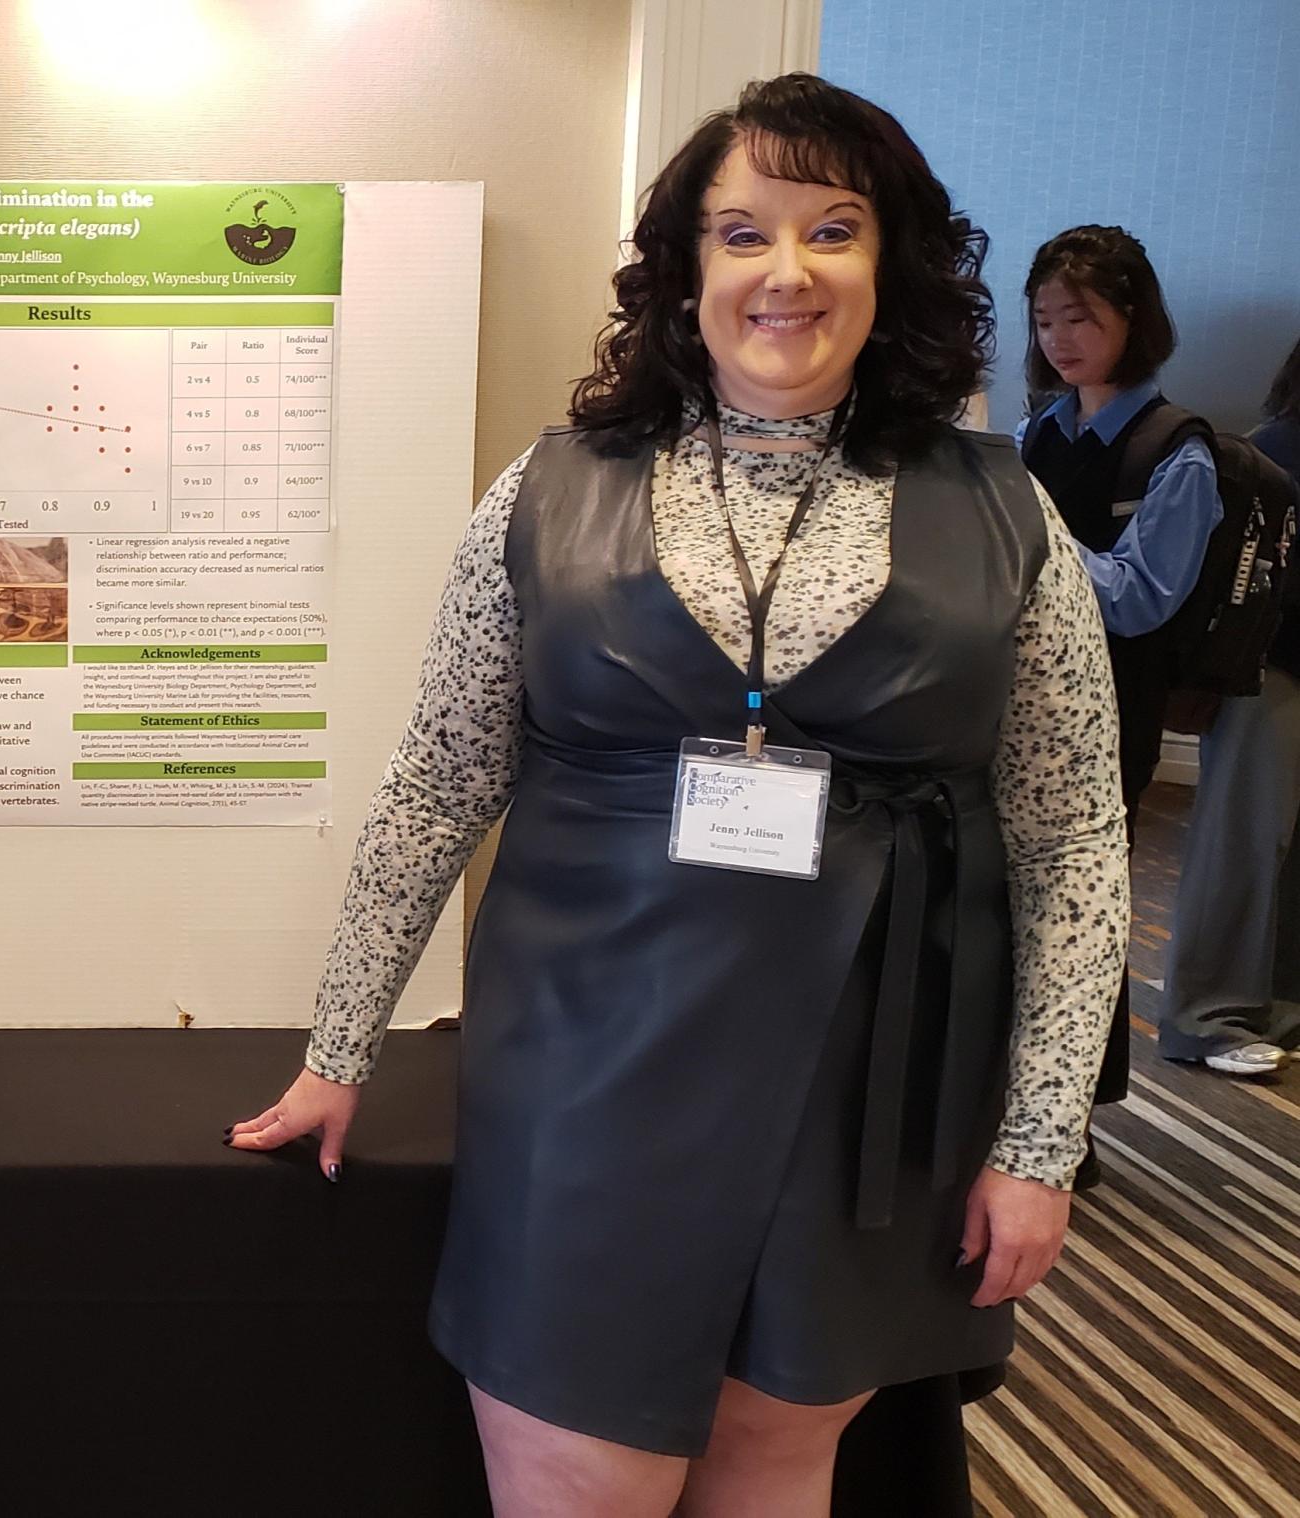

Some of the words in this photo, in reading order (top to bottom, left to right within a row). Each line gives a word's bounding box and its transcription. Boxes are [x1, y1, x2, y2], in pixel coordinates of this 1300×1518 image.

[96, 189, 117, 208] in
[121, 189, 154, 207] the
[60, 218, 140, 239] elegans)
[19, 249, 62, 263] Jellison
[61, 270, 76, 284] of
[77, 270, 149, 287] Psychology,
[151, 271, 230, 287] Waynesburg
[232, 271, 297, 286] University
[27, 305, 91, 320] Results
[190, 341, 208, 349] Pair
[242, 341, 265, 349] Ratio
[286, 335, 328, 343] Individual
[295, 346, 319, 354] Score
[187, 375, 192, 384] 2
[245, 375, 260, 383] 0.5
[186, 410, 192, 418] 4
[204, 409, 210, 418] 5
[244, 409, 259, 417] 0.8
[186, 443, 192, 451] 6
[204, 443, 211, 451] 7
[242, 443, 262, 451] 0.85
[183, 477, 190, 485] 9
[202, 477, 212, 485] 10
[243, 477, 259, 485] 0.9
[41, 500, 58, 511] 0.8
[93, 500, 111, 511] 0.9
[152, 500, 156, 511] 1
[181, 511, 190, 519] 19
[241, 510, 260, 518] 0.95
[96, 537, 124, 546] Linear
[125, 537, 170, 549] regression
[171, 536, 206, 548] analysis
[207, 536, 244, 545] revealed
[253, 536, 290, 547] negative
[140, 648, 261, 661] Acknowledgements
[95, 701, 119, 710] funding
[13, 720, 32, 730] and
[140, 715, 204, 726] Statement
[206, 714, 221, 725] of
[221, 714, 260, 725] Ethics
[163, 762, 236, 774] References
[690, 768, 757, 786] Comparative
[687, 794, 727, 809] Society
[709, 823, 739, 837] Jenny
[744, 827, 784, 840] Jellison
